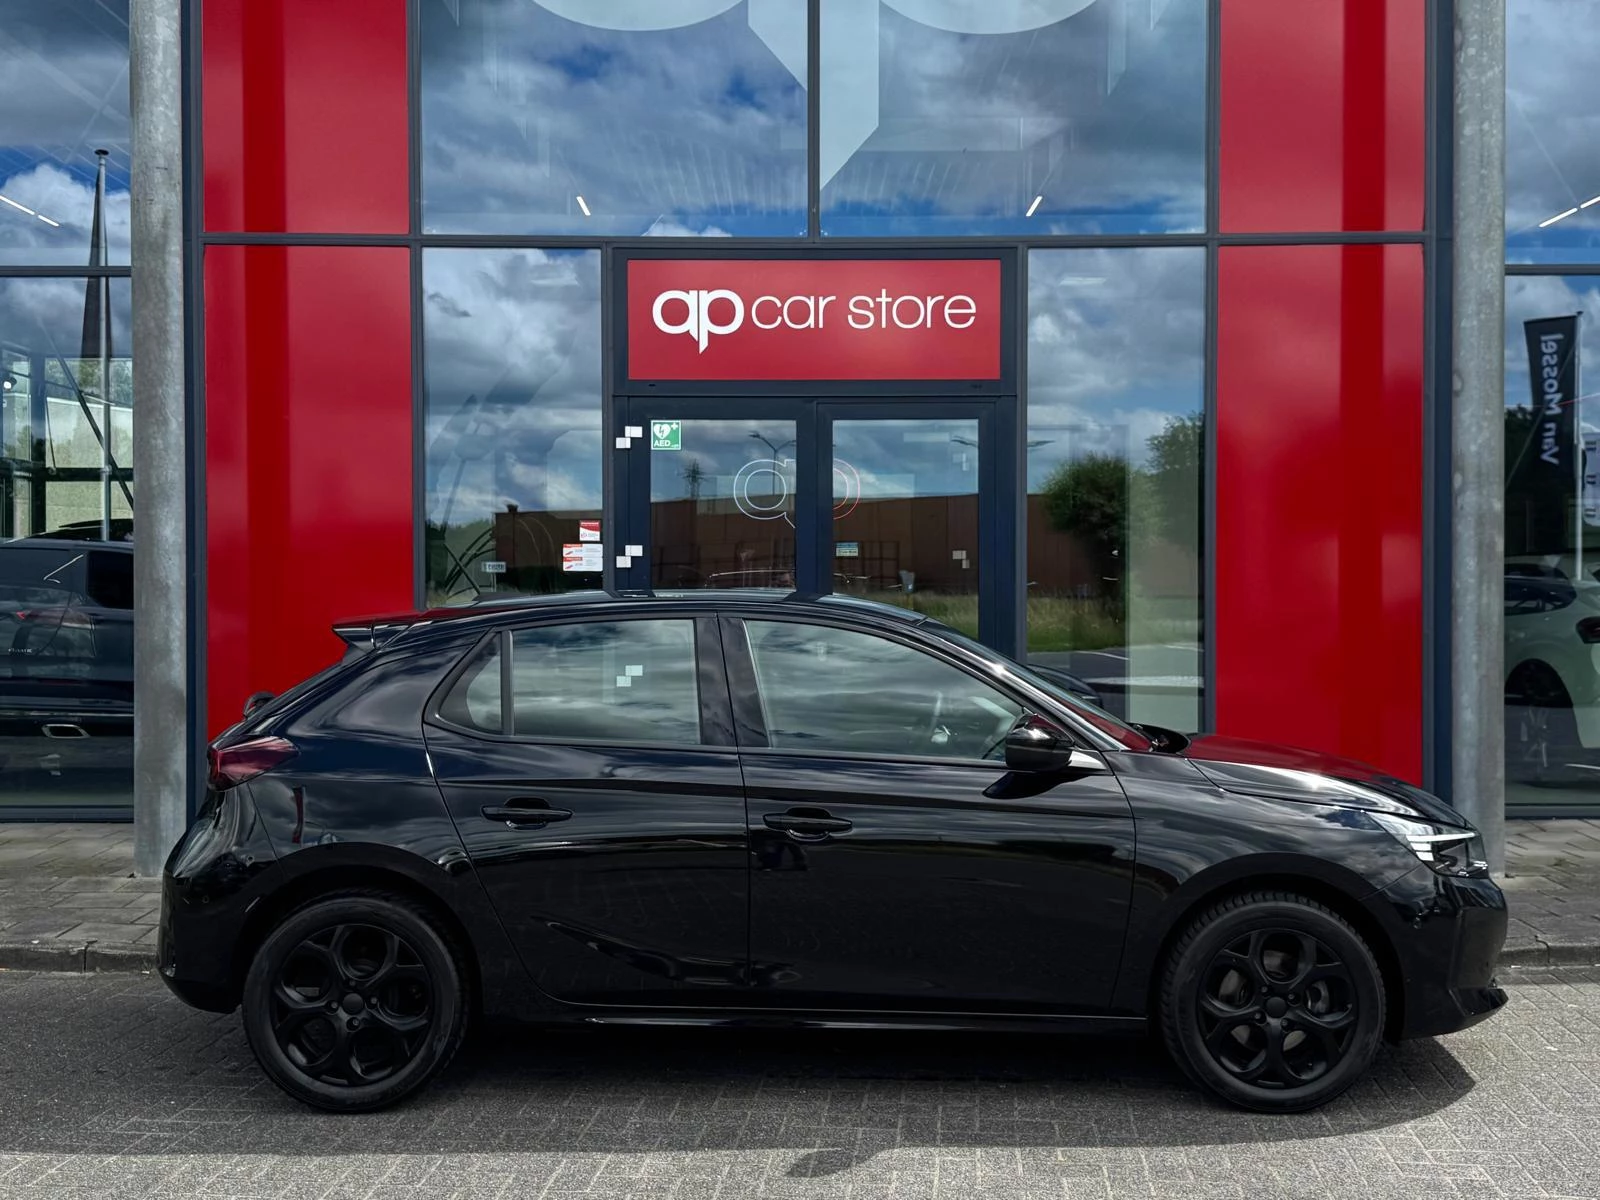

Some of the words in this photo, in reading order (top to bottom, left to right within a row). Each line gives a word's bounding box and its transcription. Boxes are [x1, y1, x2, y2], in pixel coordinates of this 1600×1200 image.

[652, 288, 745, 355] ap
[751, 295, 837, 330] car
[847, 288, 977, 330] store
[653, 439, 671, 447] AED
